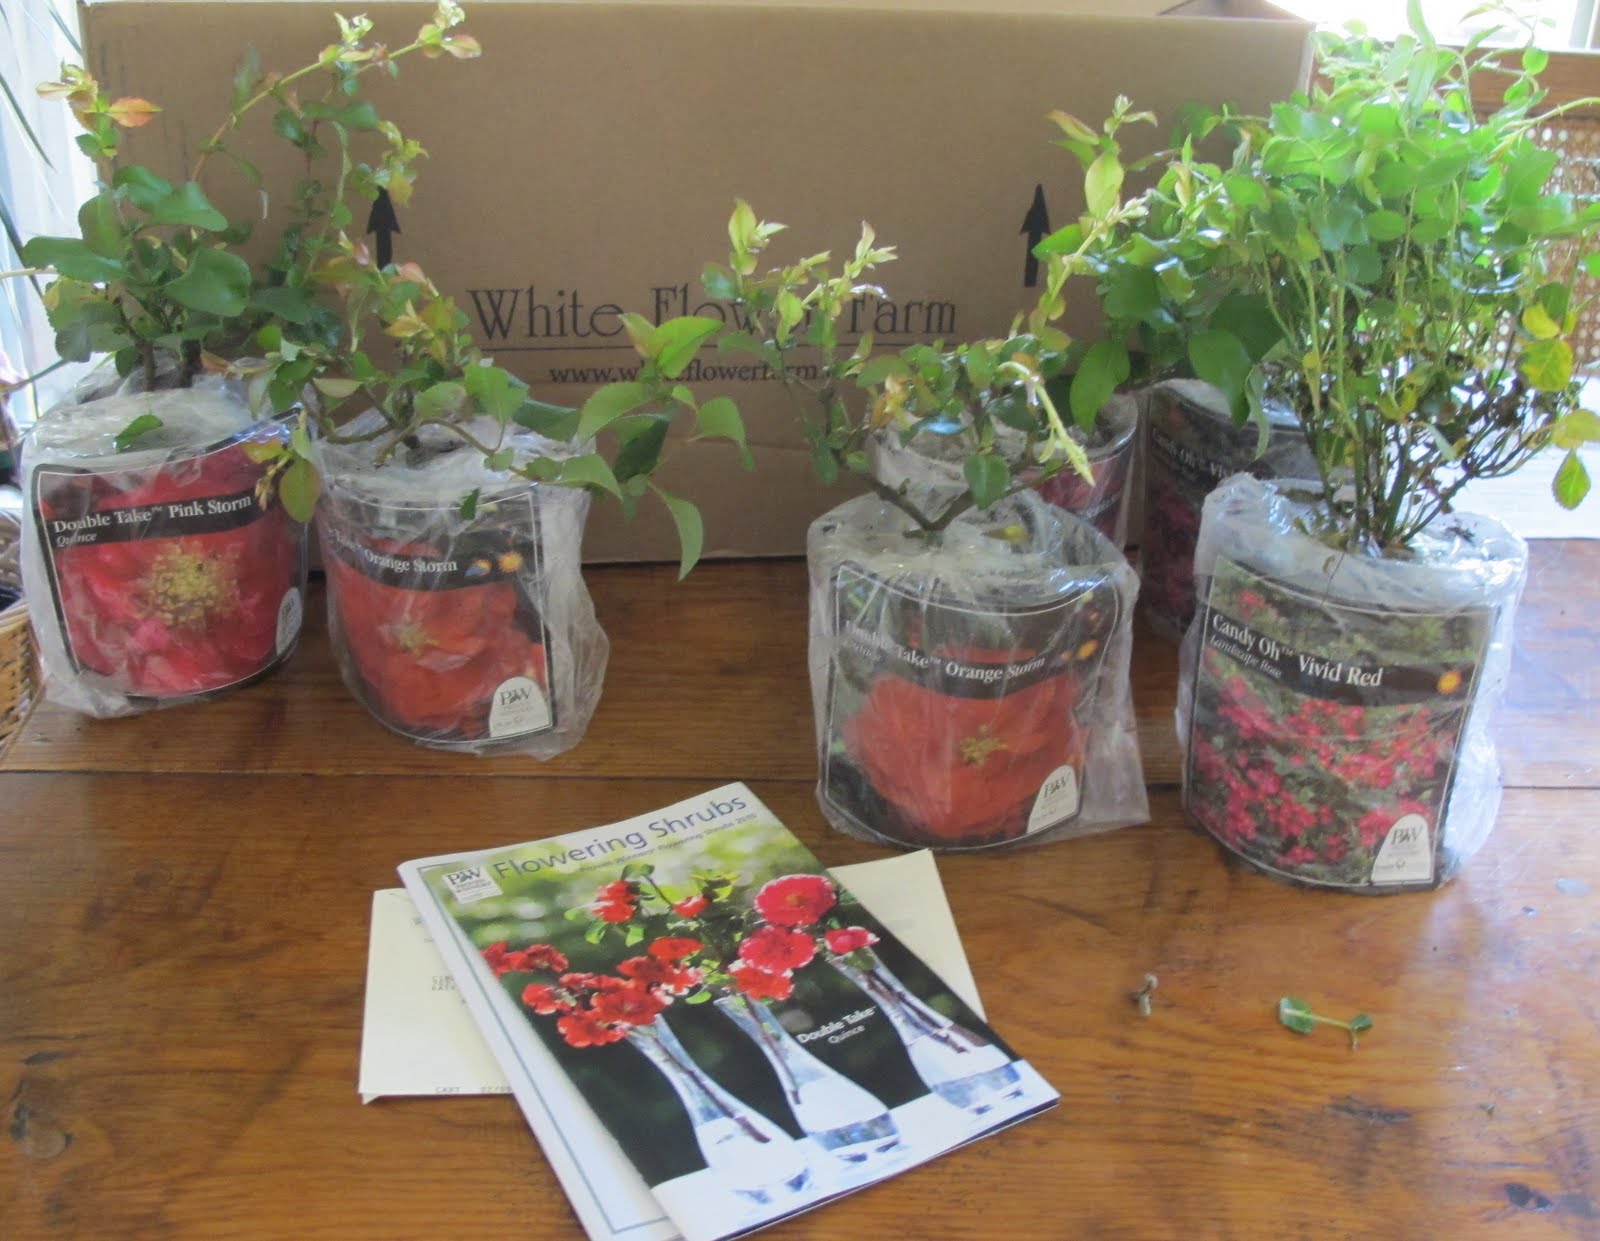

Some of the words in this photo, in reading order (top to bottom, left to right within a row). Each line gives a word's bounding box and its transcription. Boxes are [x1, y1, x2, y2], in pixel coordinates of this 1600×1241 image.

[466, 284, 626, 340] White
[651, 281, 823, 338] Flowr
[54, 513, 111, 534] Double
[168, 503, 205, 520] Pink
[207, 495, 252, 514] Storm
[56, 531, 98, 548] Quince
[364, 548, 411, 573] Orange
[413, 556, 459, 573] Storm
[1212, 613, 1257, 647] Candy
[1299, 654, 1343, 683] Vivid
[1347, 667, 1383, 688] Red
[945, 660, 1004, 685] Orange
[1006, 655, 1047, 679] Storm
[493, 828, 648, 882] Flowering
[649, 795, 747, 838] Shrubs
[796, 1020, 846, 1044] Double
[827, 1024, 866, 1045] Quince
